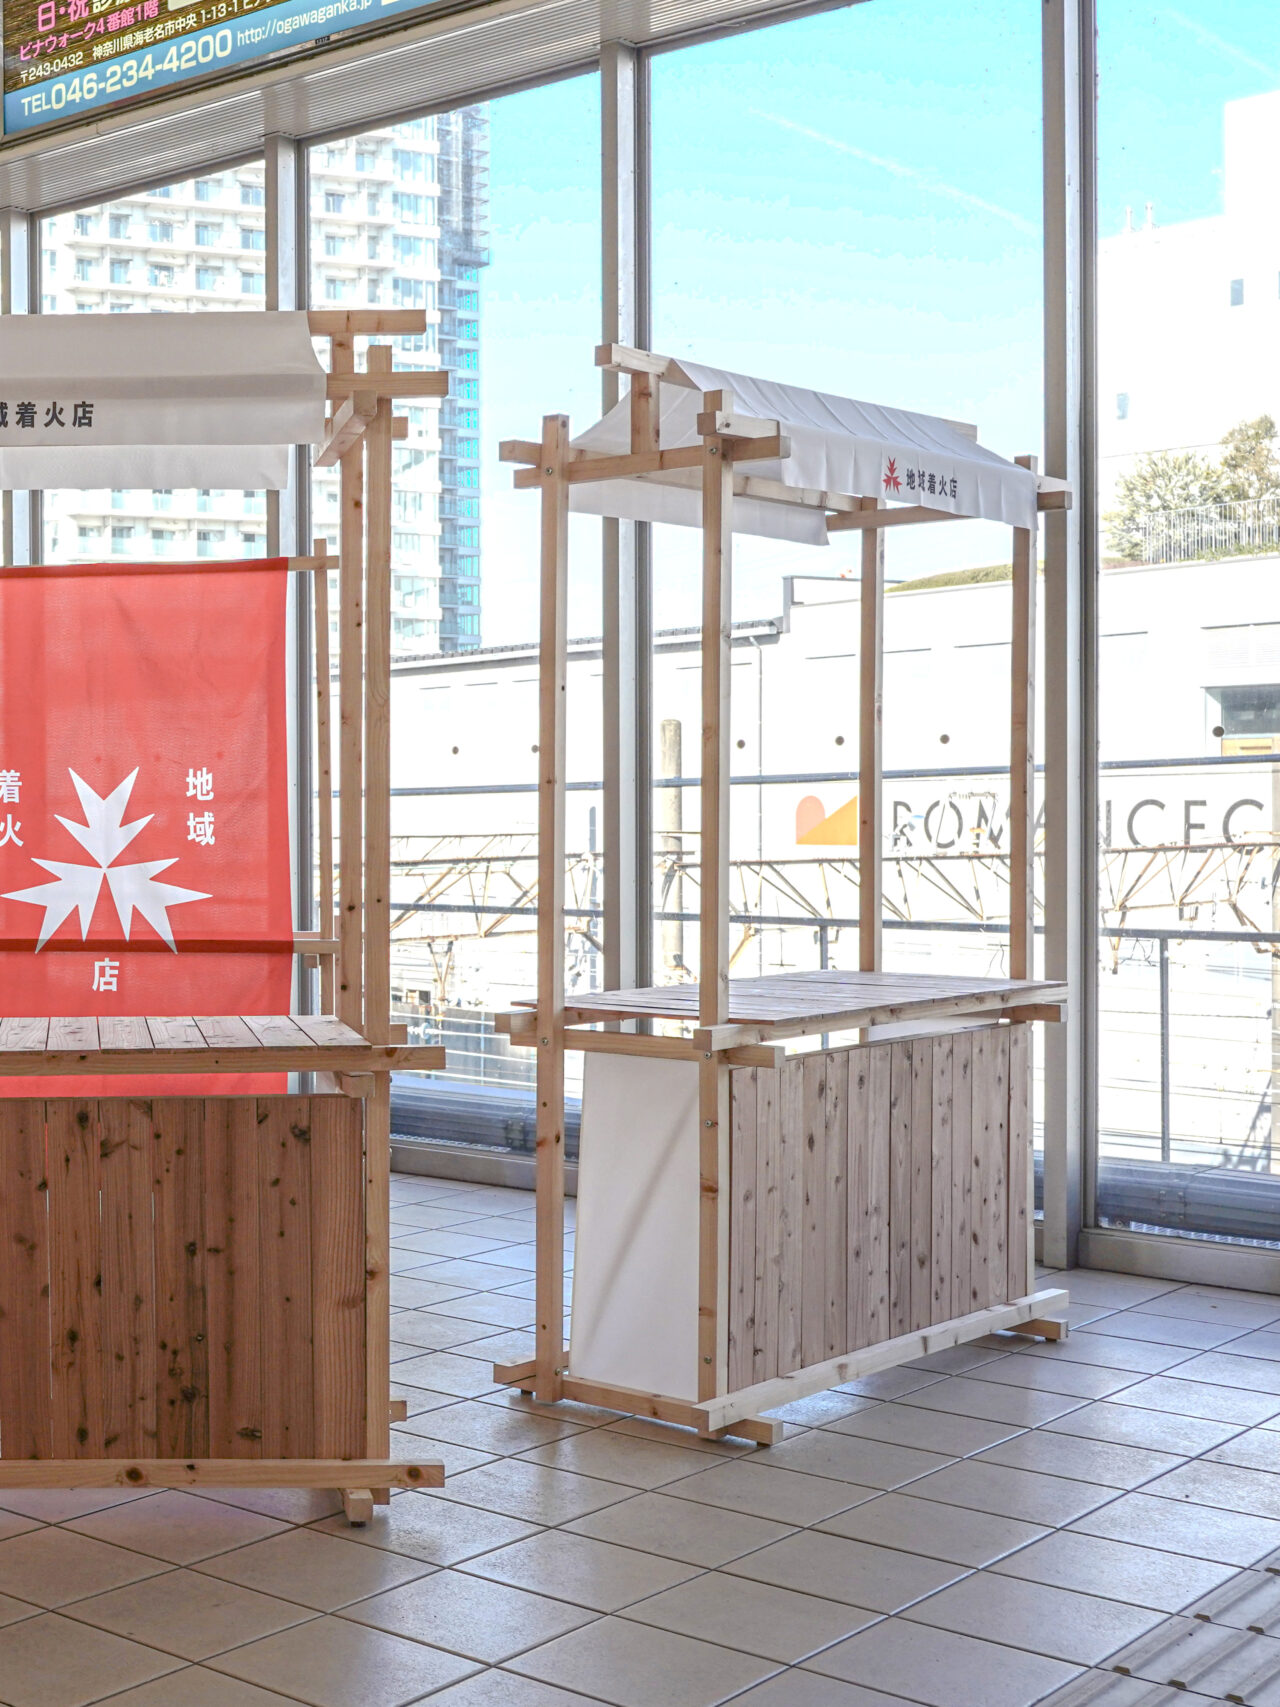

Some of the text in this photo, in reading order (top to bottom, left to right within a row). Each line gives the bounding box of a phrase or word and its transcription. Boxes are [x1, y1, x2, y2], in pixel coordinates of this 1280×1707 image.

[20, 0, 159, 61] ビナウォーク4番館1階
[93, 13, 197, 60] 神奈川県海老名市中央
[906, 468, 957, 499] 地域着火店
[186, 767, 216, 846] 地域
[92, 957, 120, 992] 店
